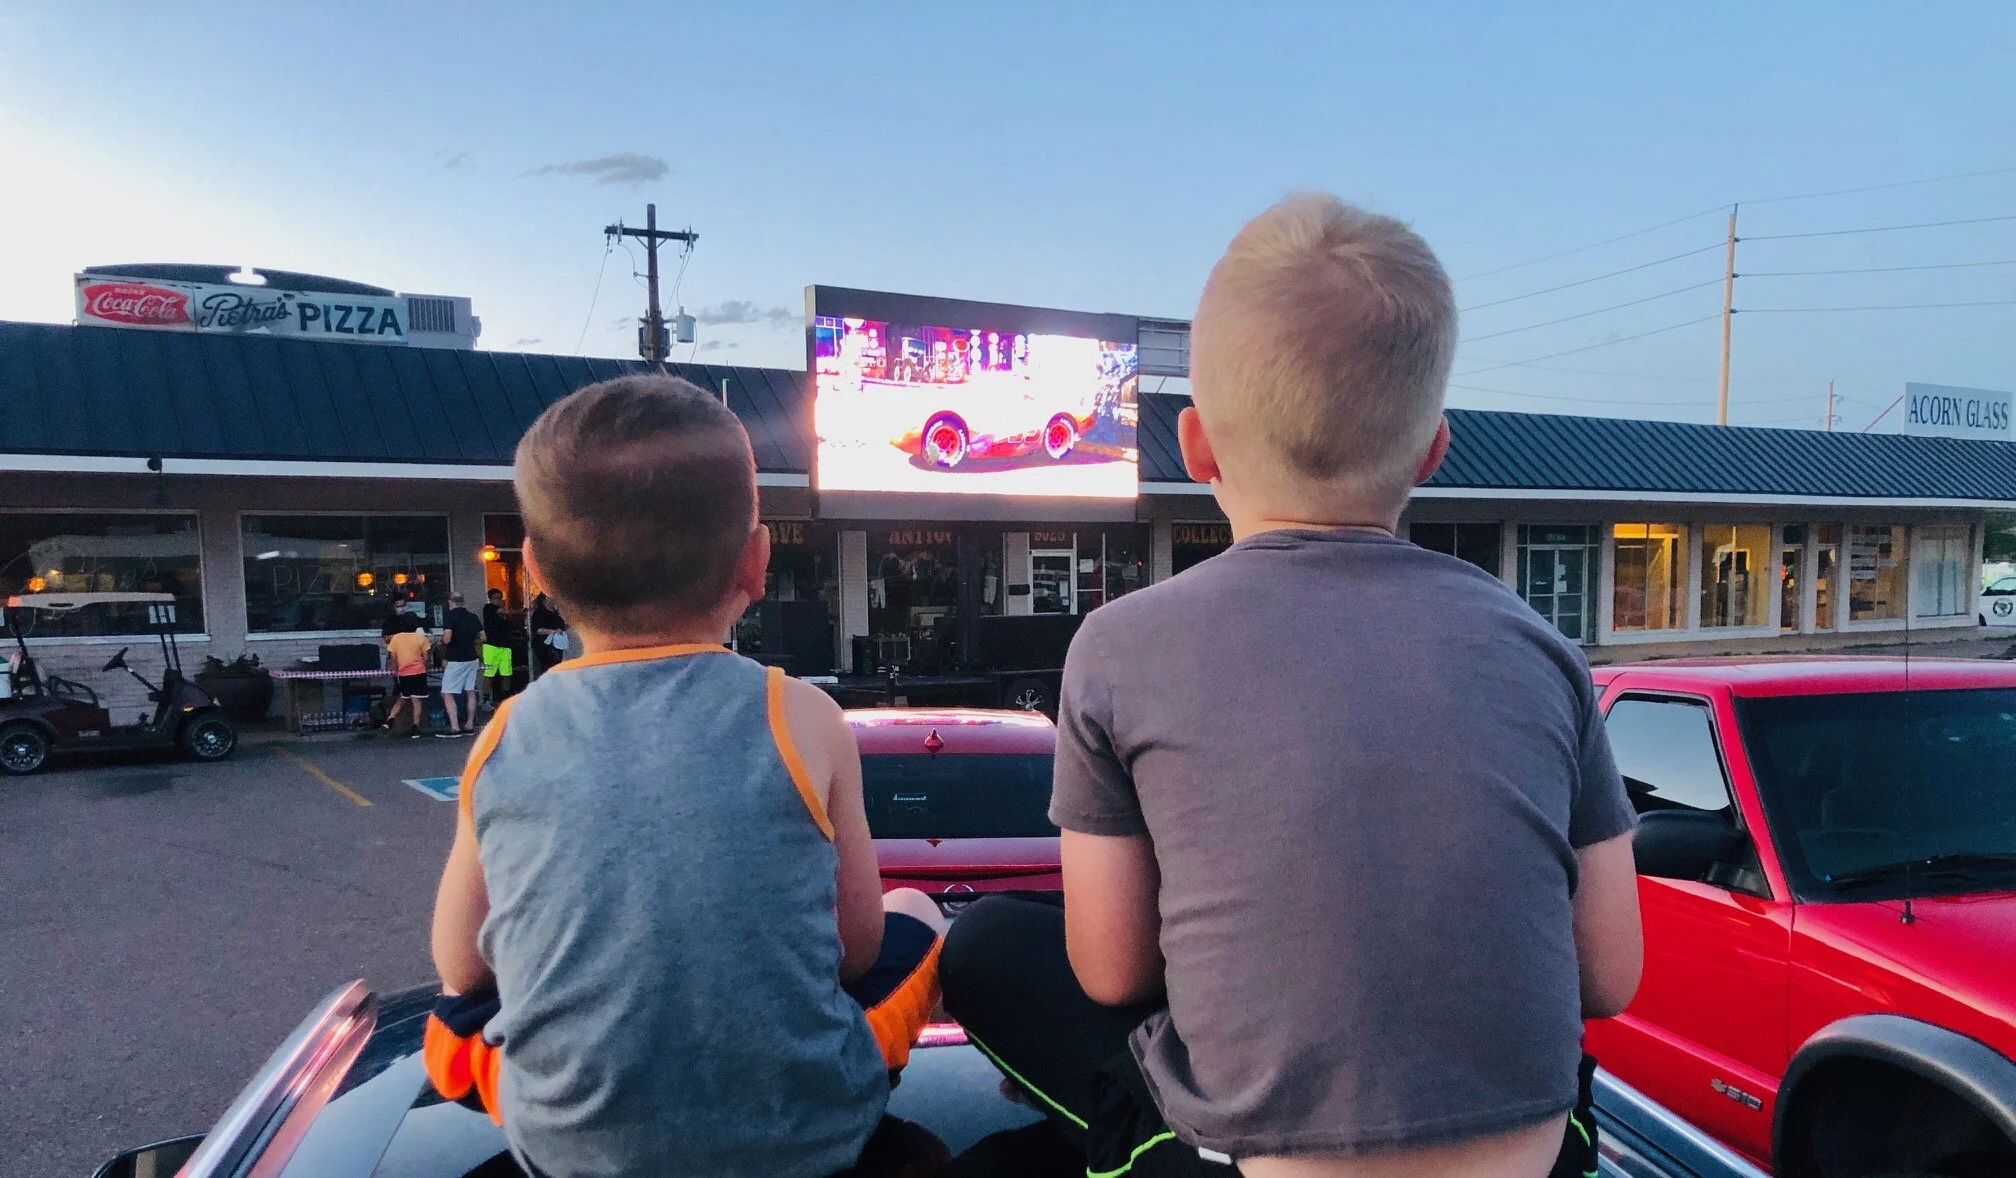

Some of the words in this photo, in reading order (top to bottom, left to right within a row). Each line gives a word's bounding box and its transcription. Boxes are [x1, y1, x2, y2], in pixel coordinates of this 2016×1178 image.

[92, 291, 180, 319] Coca-Cola
[297, 302, 403, 336] PIZZA
[1908, 394, 1962, 426] ACORN
[1966, 399, 2008, 430] GLASS
